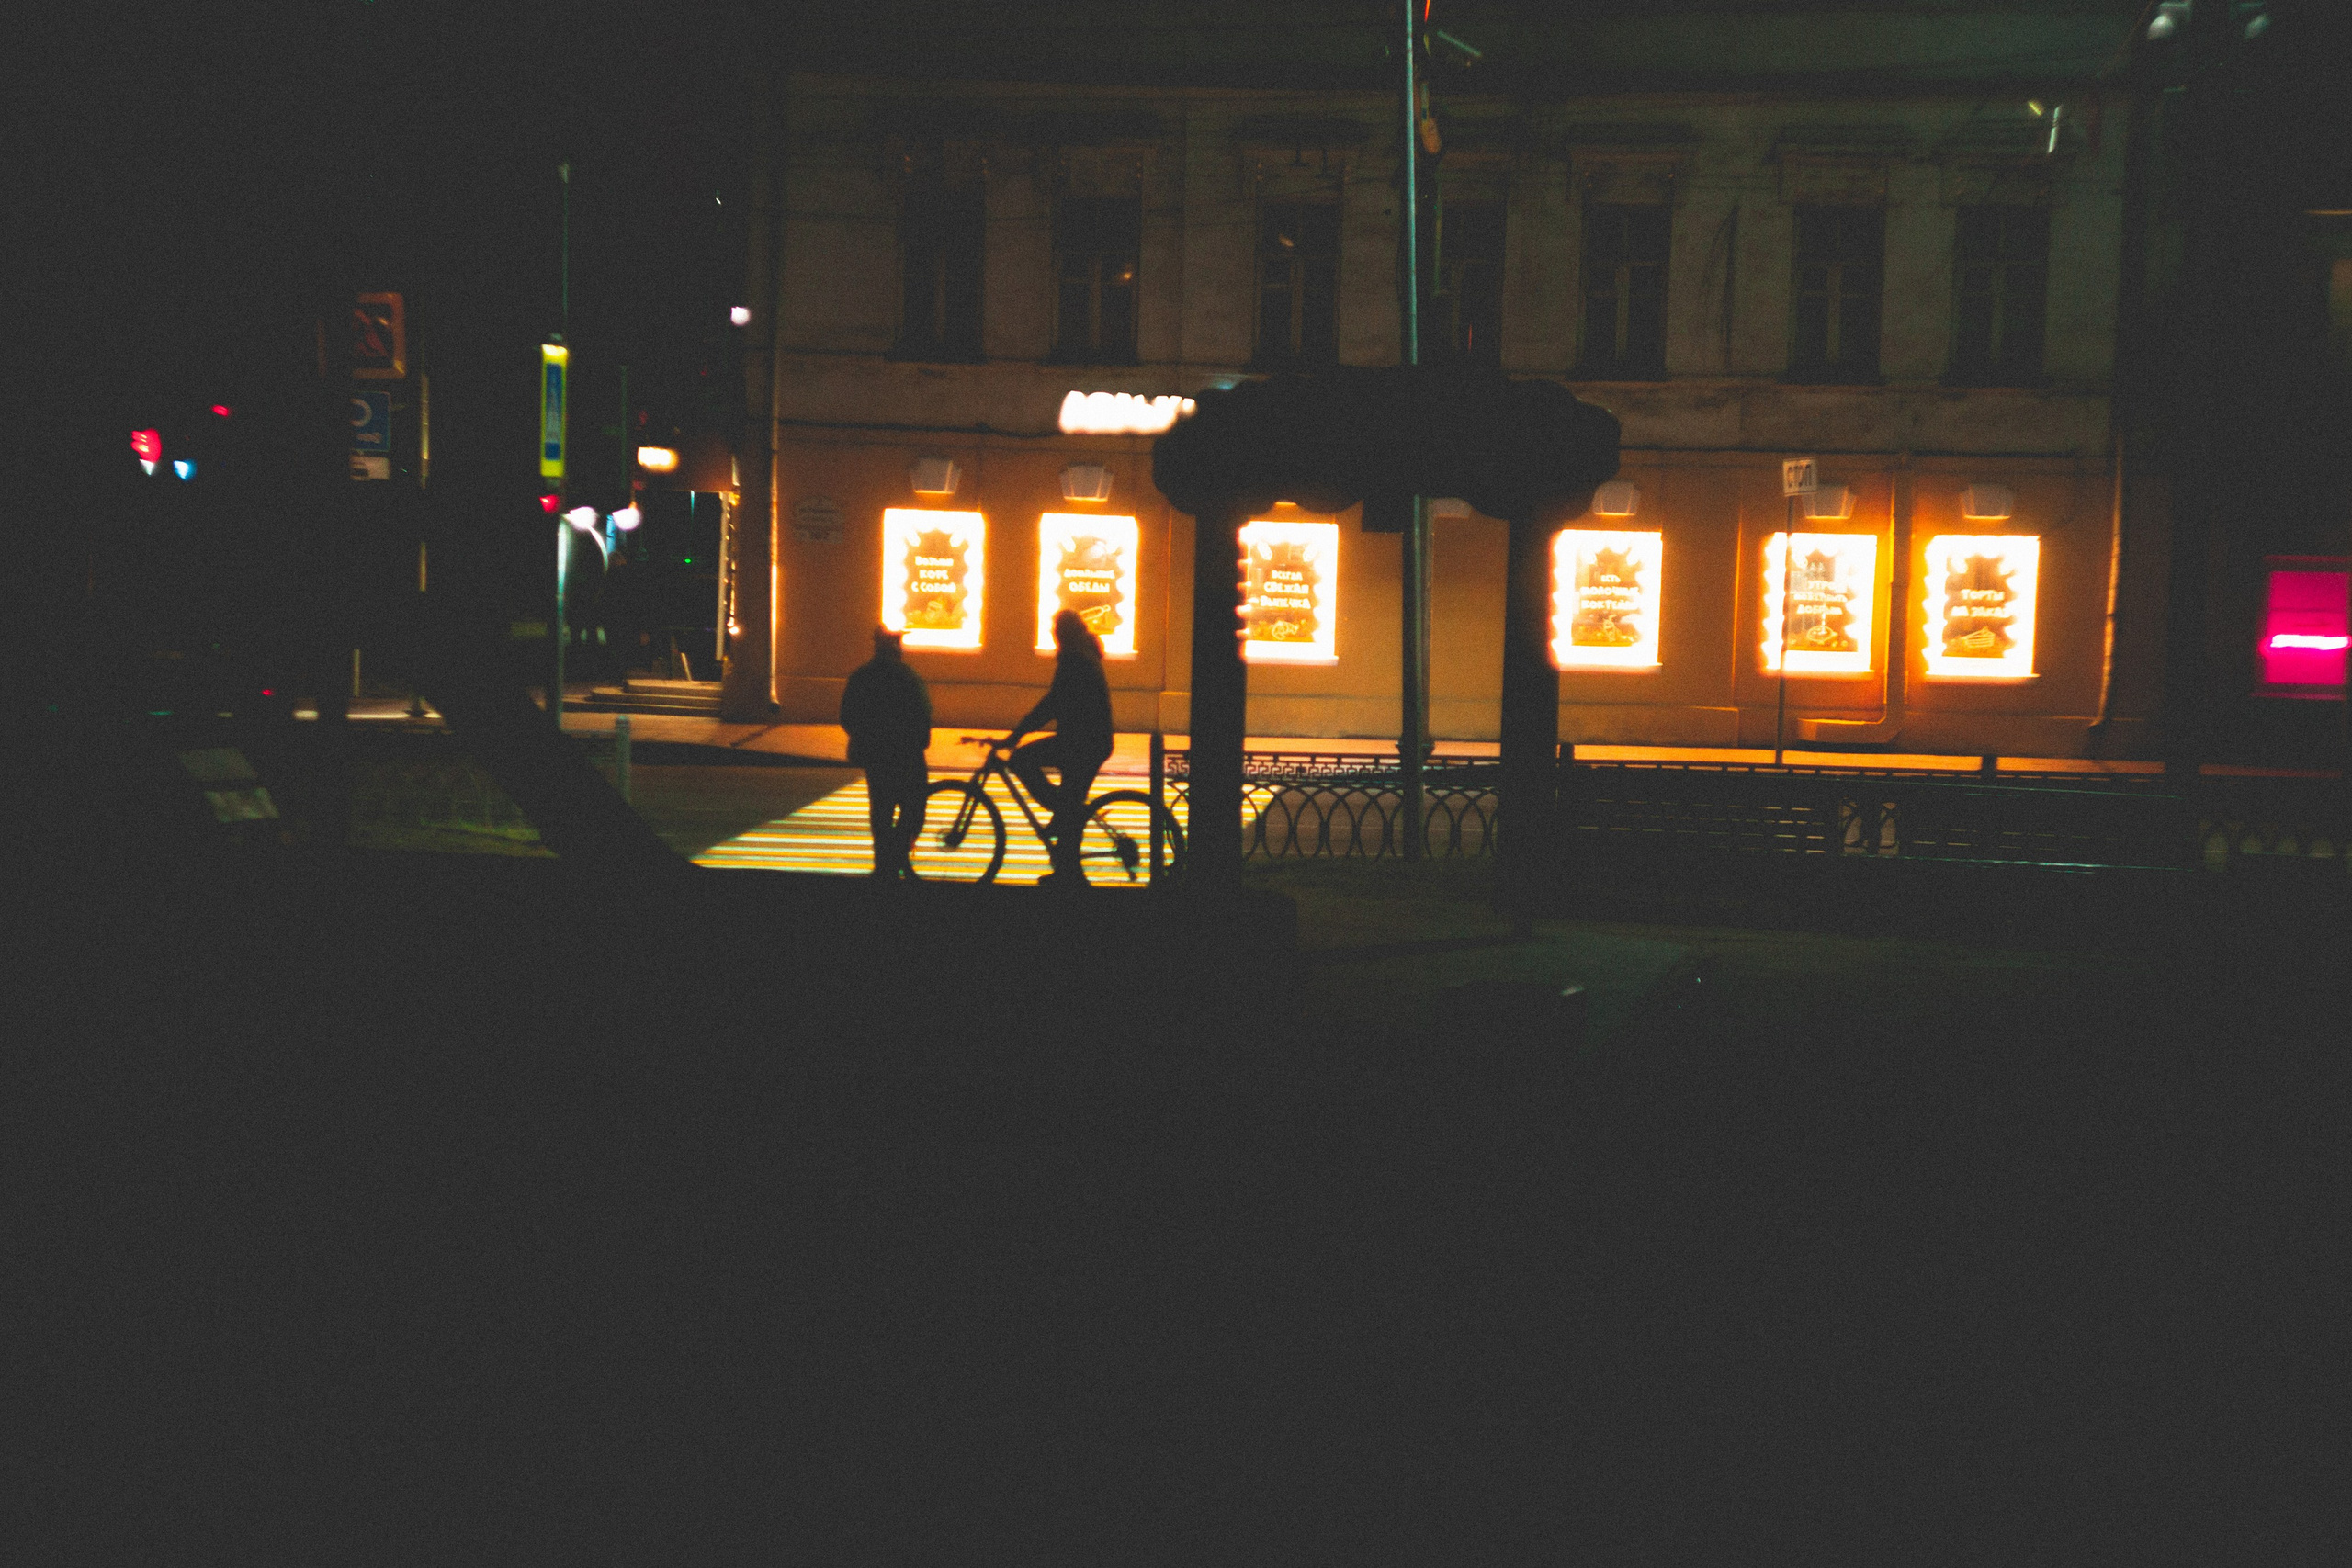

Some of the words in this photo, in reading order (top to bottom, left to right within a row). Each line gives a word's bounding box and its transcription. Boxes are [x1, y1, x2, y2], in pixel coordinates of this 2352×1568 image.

[1787, 463, 1813, 489] СТОП
[1600, 574, 1622, 583] ЕСТЬ
[910, 581, 920, 592] С
[1069, 581, 1111, 593] ОБЕДЫ
[1263, 581, 1310, 594] СВЕЖАЯ
[1959, 587, 2005, 601] ТОРТЫ
[1260, 594, 1312, 609] ВЫПЕЧКА
